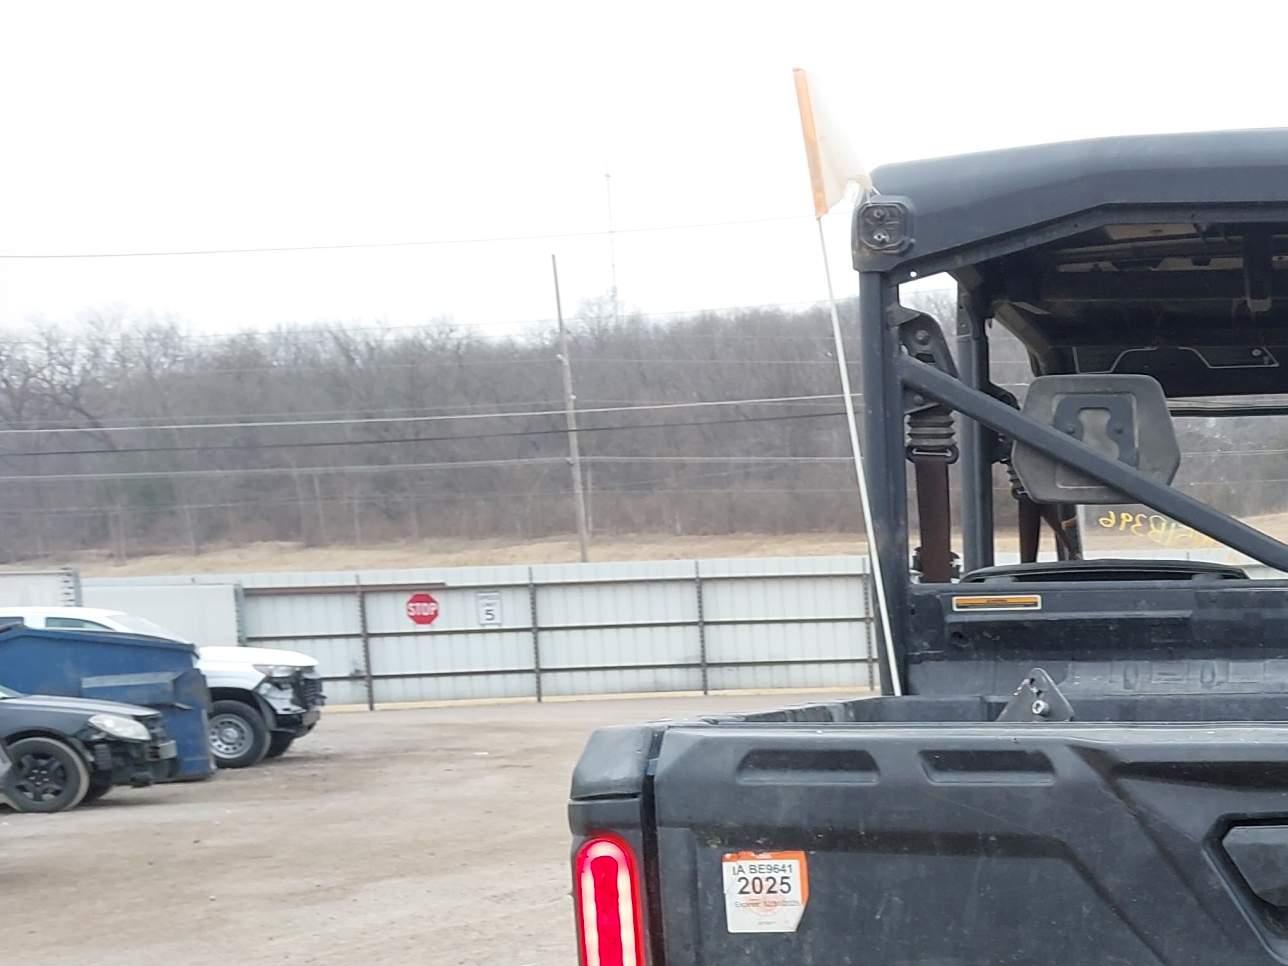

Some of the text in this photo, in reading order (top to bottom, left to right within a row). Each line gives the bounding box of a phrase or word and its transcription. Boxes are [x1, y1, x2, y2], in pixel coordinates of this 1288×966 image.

[408, 602, 437, 616] STOP
[485, 608, 495, 621] 5
[737, 876, 792, 895] 2025
